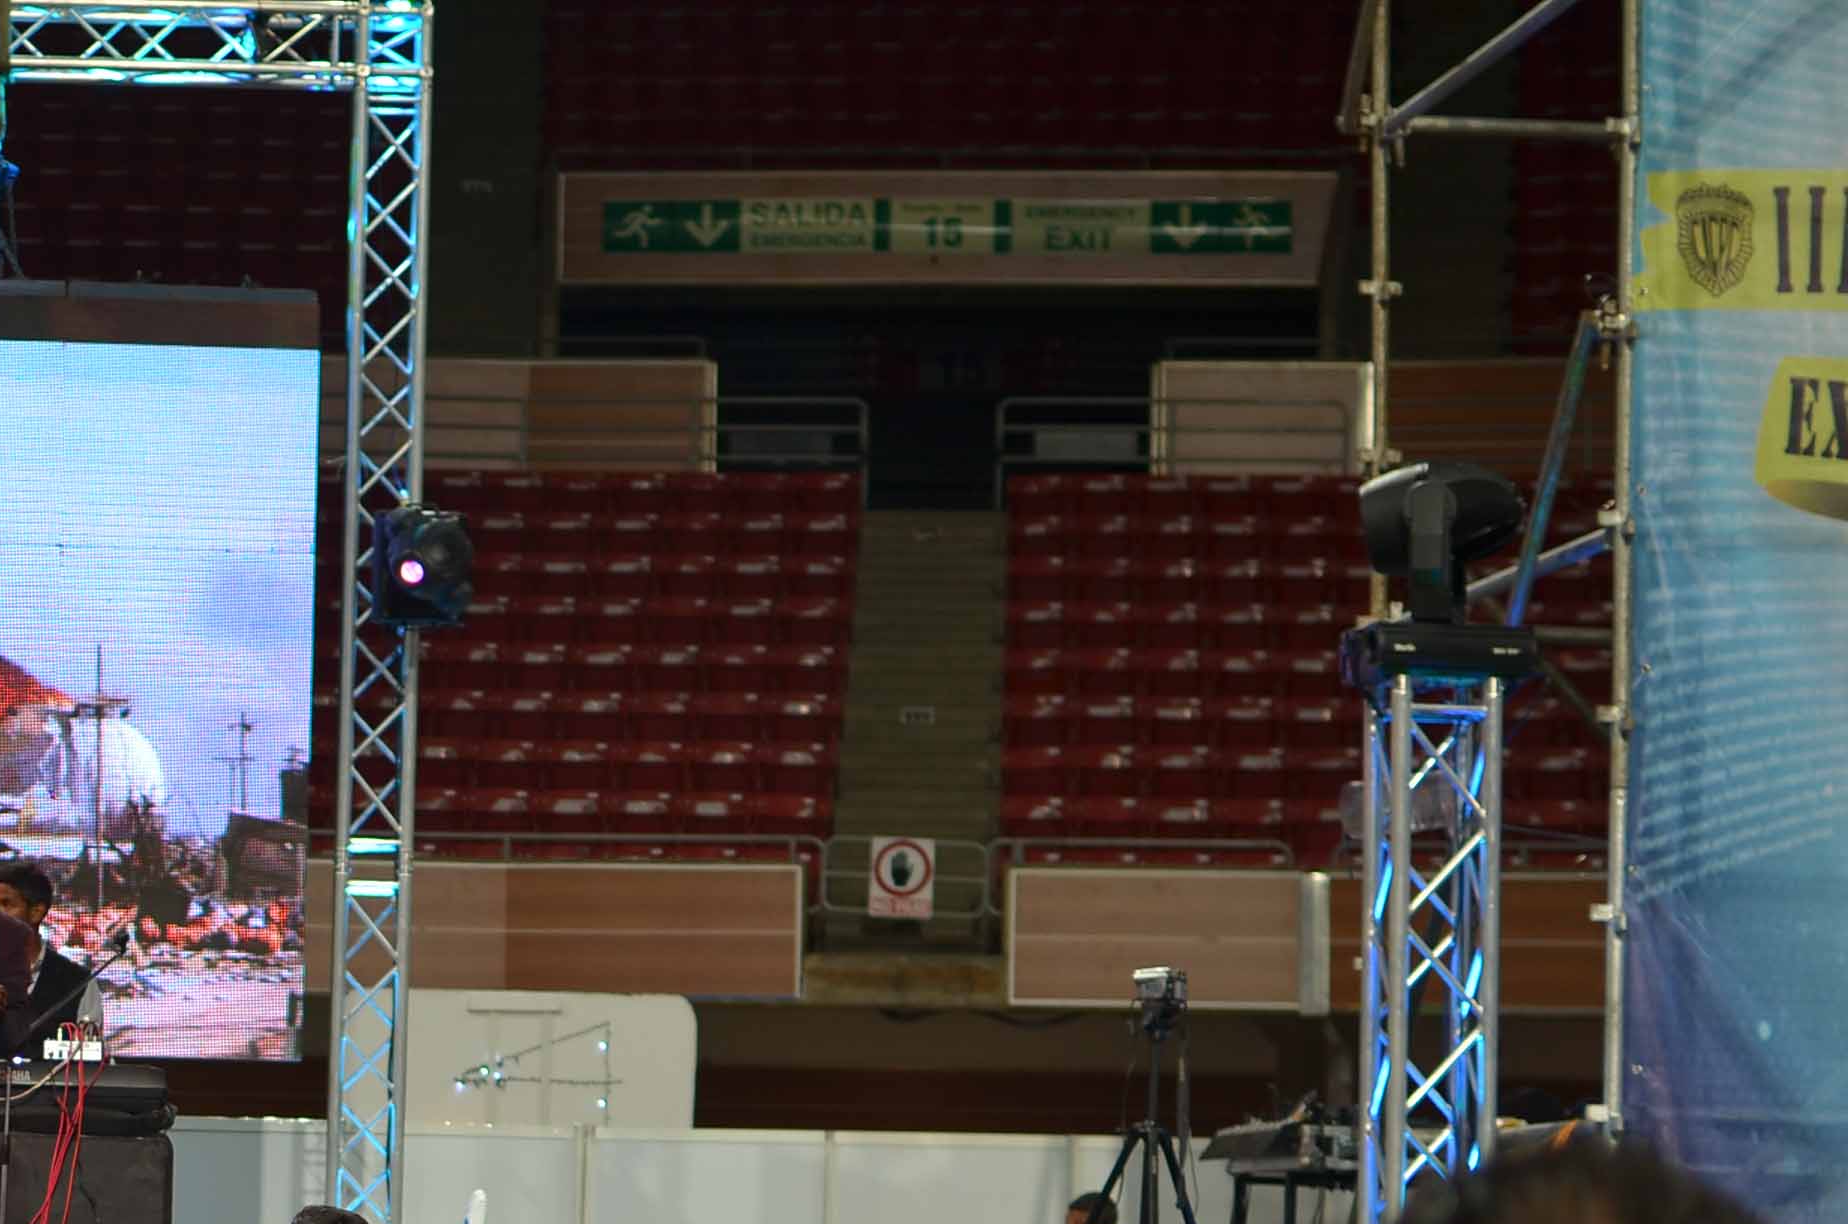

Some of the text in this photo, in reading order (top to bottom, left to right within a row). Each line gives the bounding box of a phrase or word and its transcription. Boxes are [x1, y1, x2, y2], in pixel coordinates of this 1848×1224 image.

[750, 201, 867, 226] SALIDA
[924, 216, 963, 247] 15
[1046, 224, 1112, 250] EXIT
